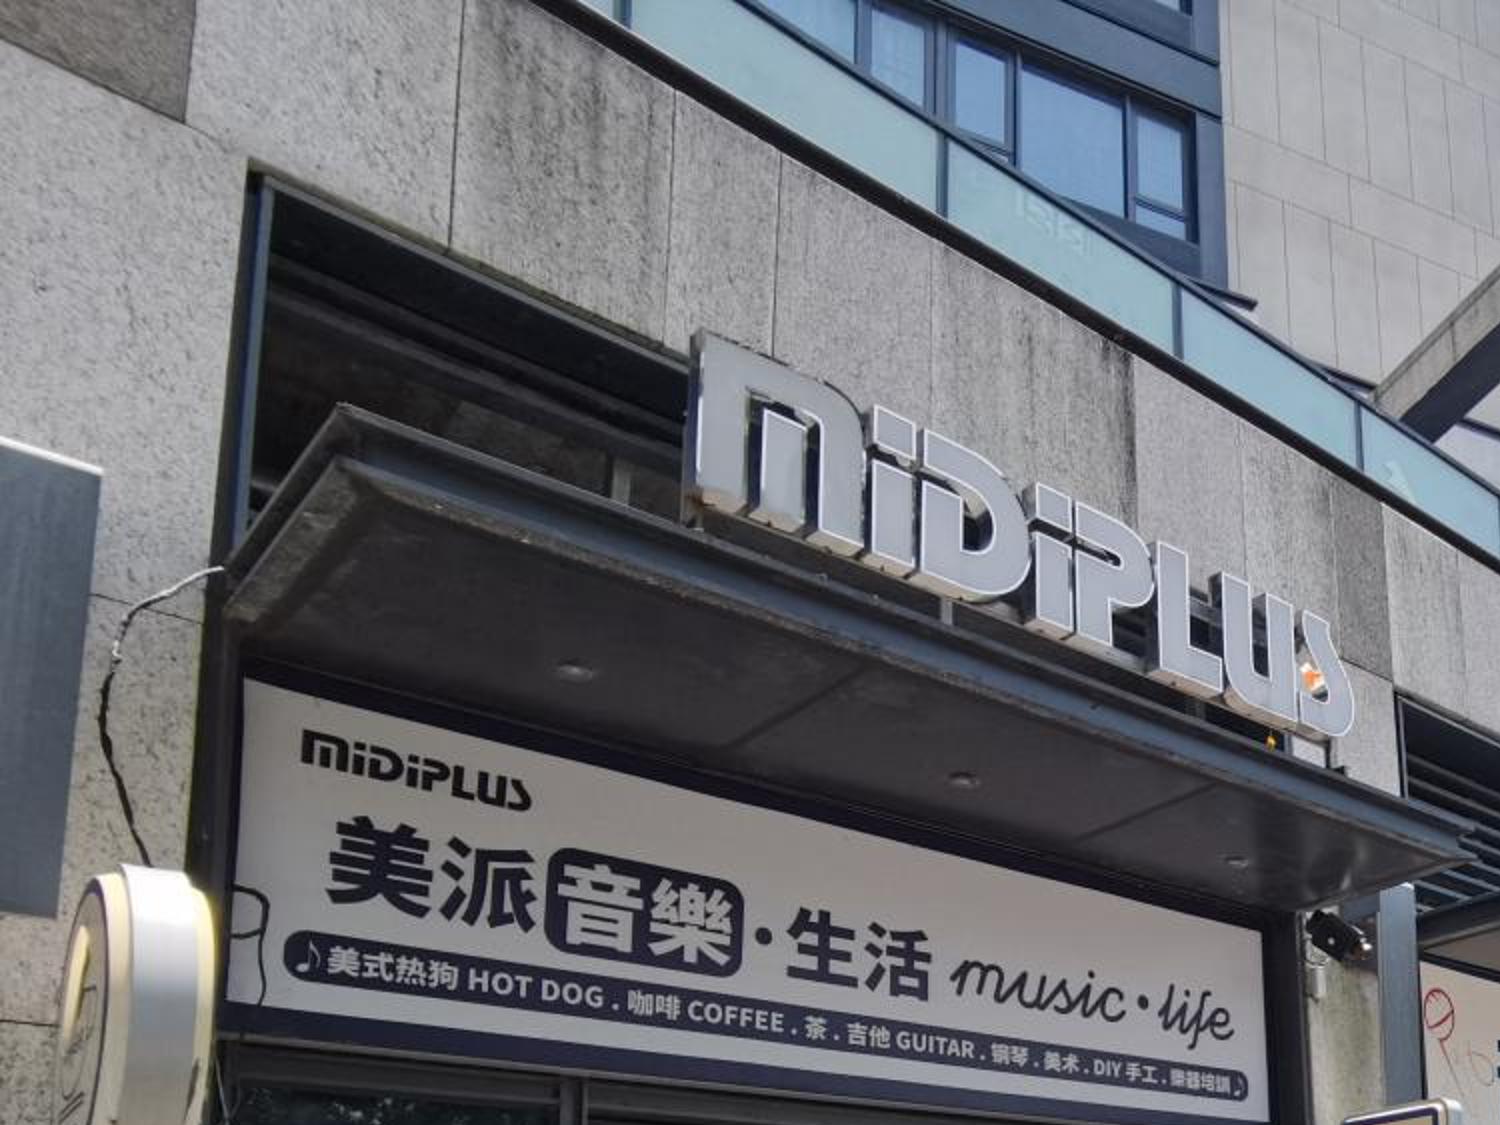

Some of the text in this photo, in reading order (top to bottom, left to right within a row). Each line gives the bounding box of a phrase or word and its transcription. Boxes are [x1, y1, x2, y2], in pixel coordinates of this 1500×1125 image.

[327, 945, 459, 992] 美式热狗
[468, 968, 533, 999] HOT
[541, 978, 604, 1008] DOG
[627, 989, 681, 1020] 咖啡
[687, 1000, 785, 1033] COFFEE
[847, 1022, 891, 1049] 吉他
[895, 1031, 975, 1059] GUITAR
[1093, 1059, 1123, 1079] DIY
[1125, 1063, 1159, 1085] 手工
